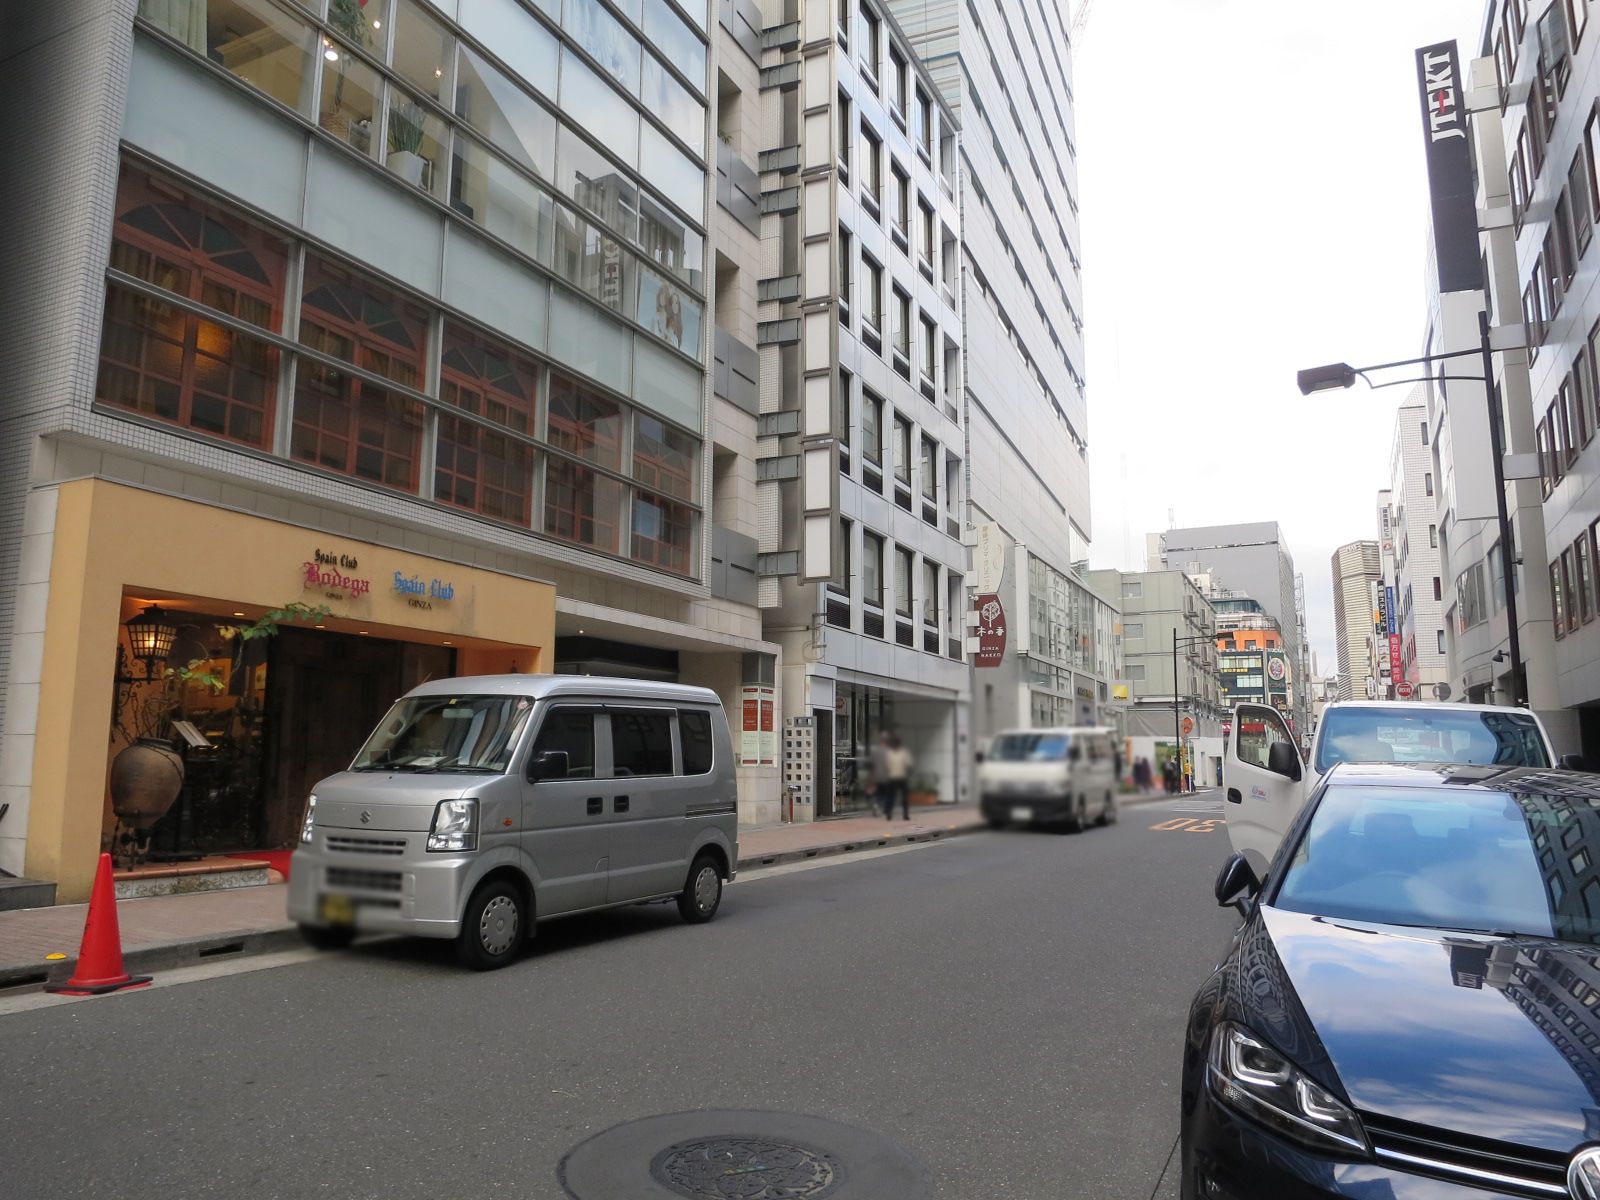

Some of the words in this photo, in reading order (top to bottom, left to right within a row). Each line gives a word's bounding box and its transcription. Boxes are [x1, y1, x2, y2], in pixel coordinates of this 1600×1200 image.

[1423, 51, 1465, 143] JTEKT
[315, 548, 337, 564] Spain
[340, 554, 358, 569] Club
[303, 562, 370, 598] Bodega
[394, 571, 425, 594] Spain
[431, 579, 454, 599] Club
[408, 598, 432, 610] GINZA
[976, 626, 1005, 637] 木の香
